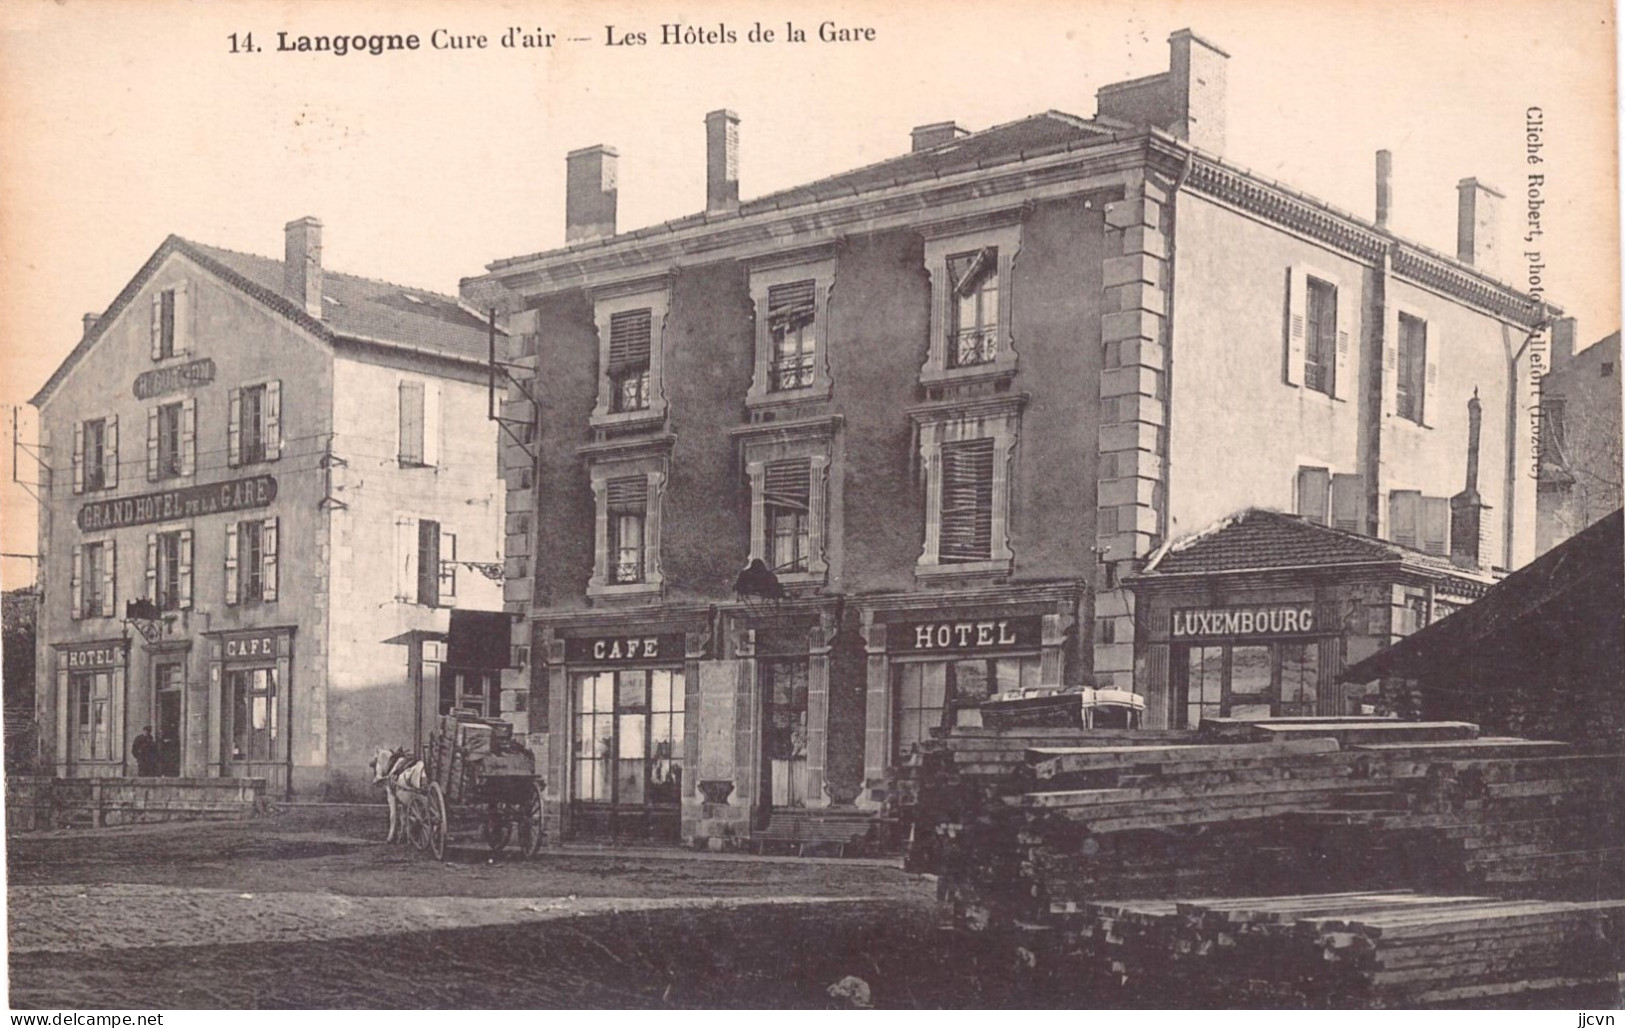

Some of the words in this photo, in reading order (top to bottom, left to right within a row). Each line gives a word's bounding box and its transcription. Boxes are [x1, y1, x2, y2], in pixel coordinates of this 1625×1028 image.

[83, 500, 133, 528] GRAND
[201, 498, 217, 511] LA
[220, 478, 268, 506] GARE
[1173, 608, 1313, 636] LUXEMBOURG
[915, 621, 1017, 648] HOTEL
[69, 649, 114, 666] HOTEL
[227, 638, 272, 656] CAFE
[593, 639, 659, 659] CAFE
